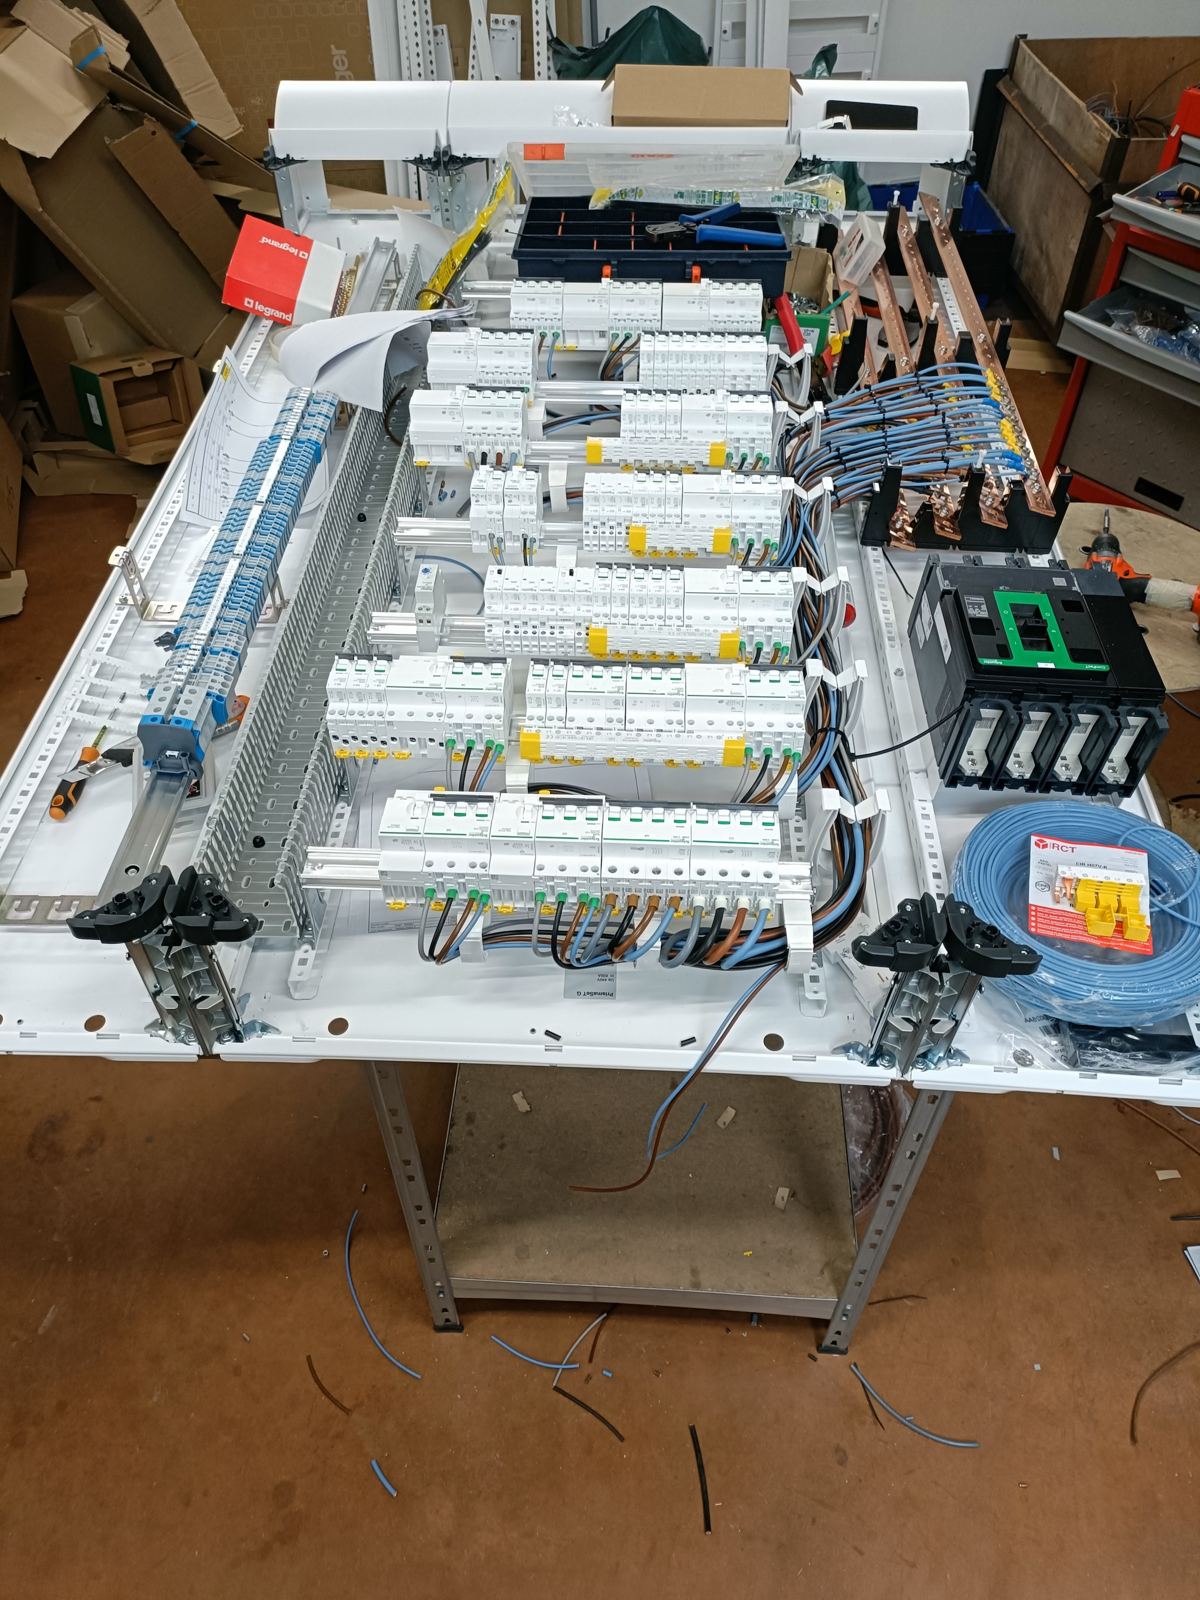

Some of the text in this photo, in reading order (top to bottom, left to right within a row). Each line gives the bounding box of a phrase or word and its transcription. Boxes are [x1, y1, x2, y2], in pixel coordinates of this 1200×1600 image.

[260, 236, 299, 256] legrand
[255, 301, 292, 322] legrand
[1052, 843, 1078, 853] RCT
